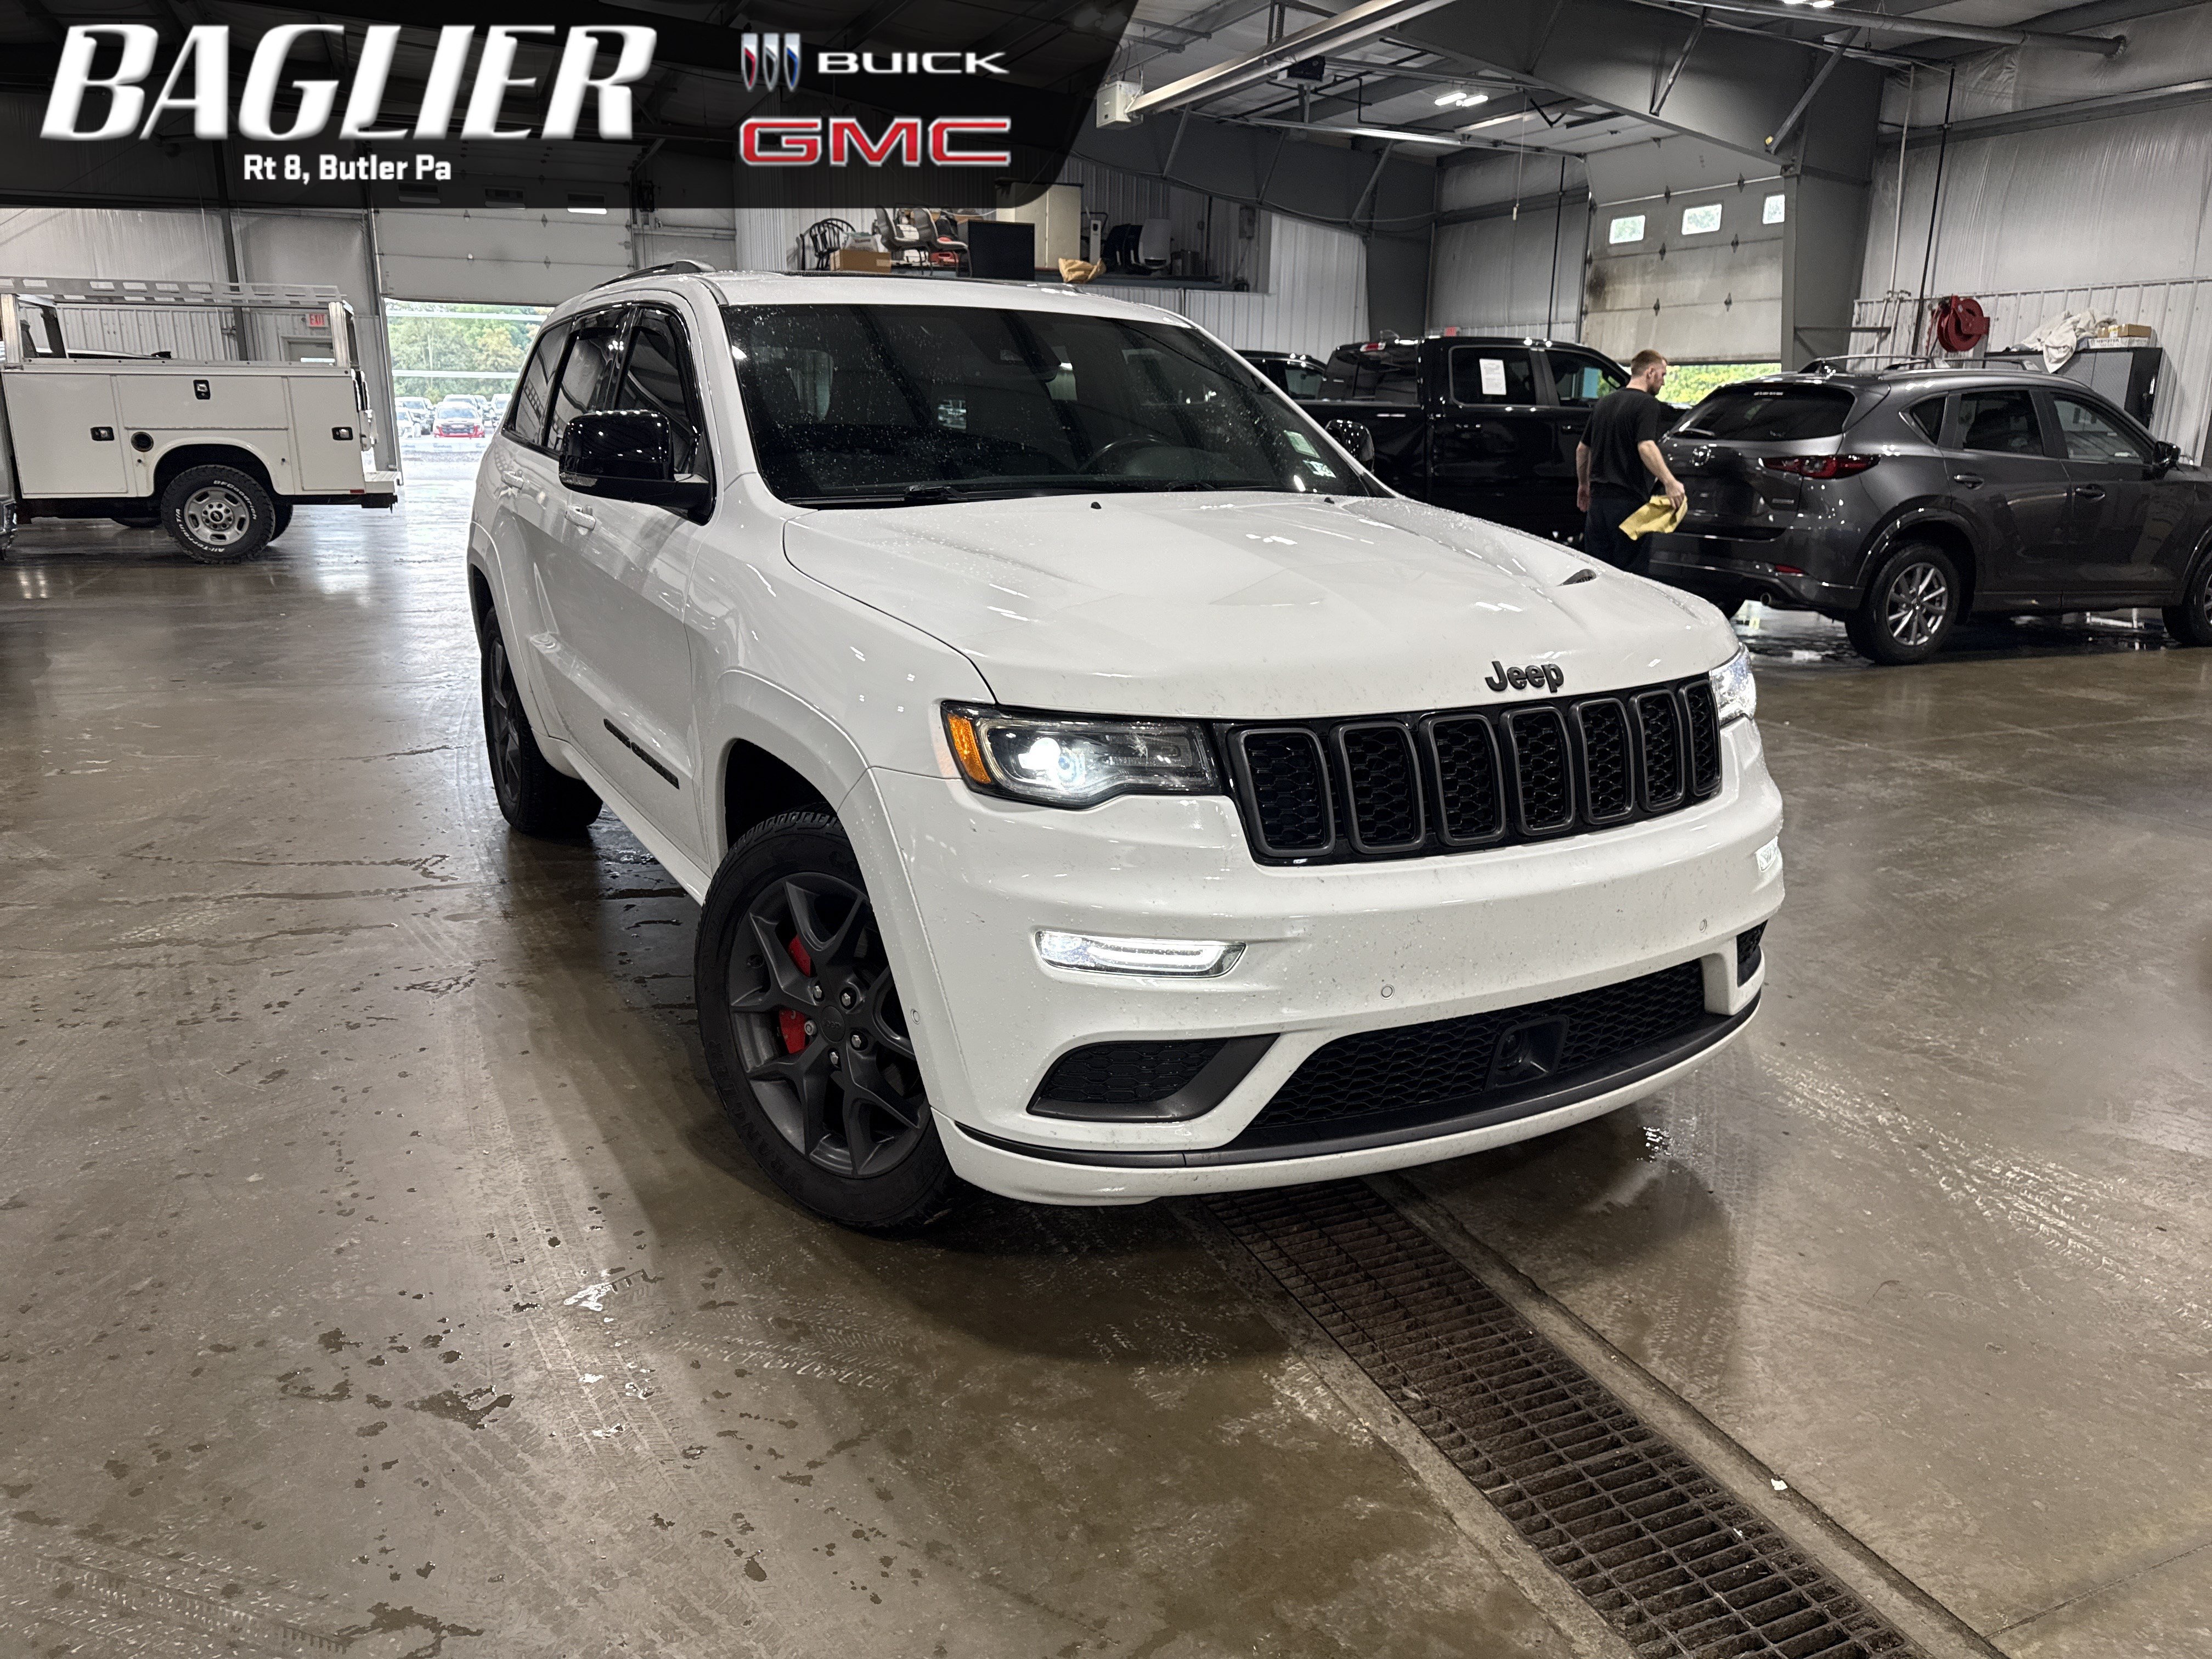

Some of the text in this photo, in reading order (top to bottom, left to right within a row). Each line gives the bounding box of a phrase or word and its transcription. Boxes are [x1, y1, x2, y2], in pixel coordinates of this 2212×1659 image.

[309, 313, 325, 325] EXIT
[213, 480, 257, 520] BFGoodrich
[1485, 661, 1564, 693] Jeep
